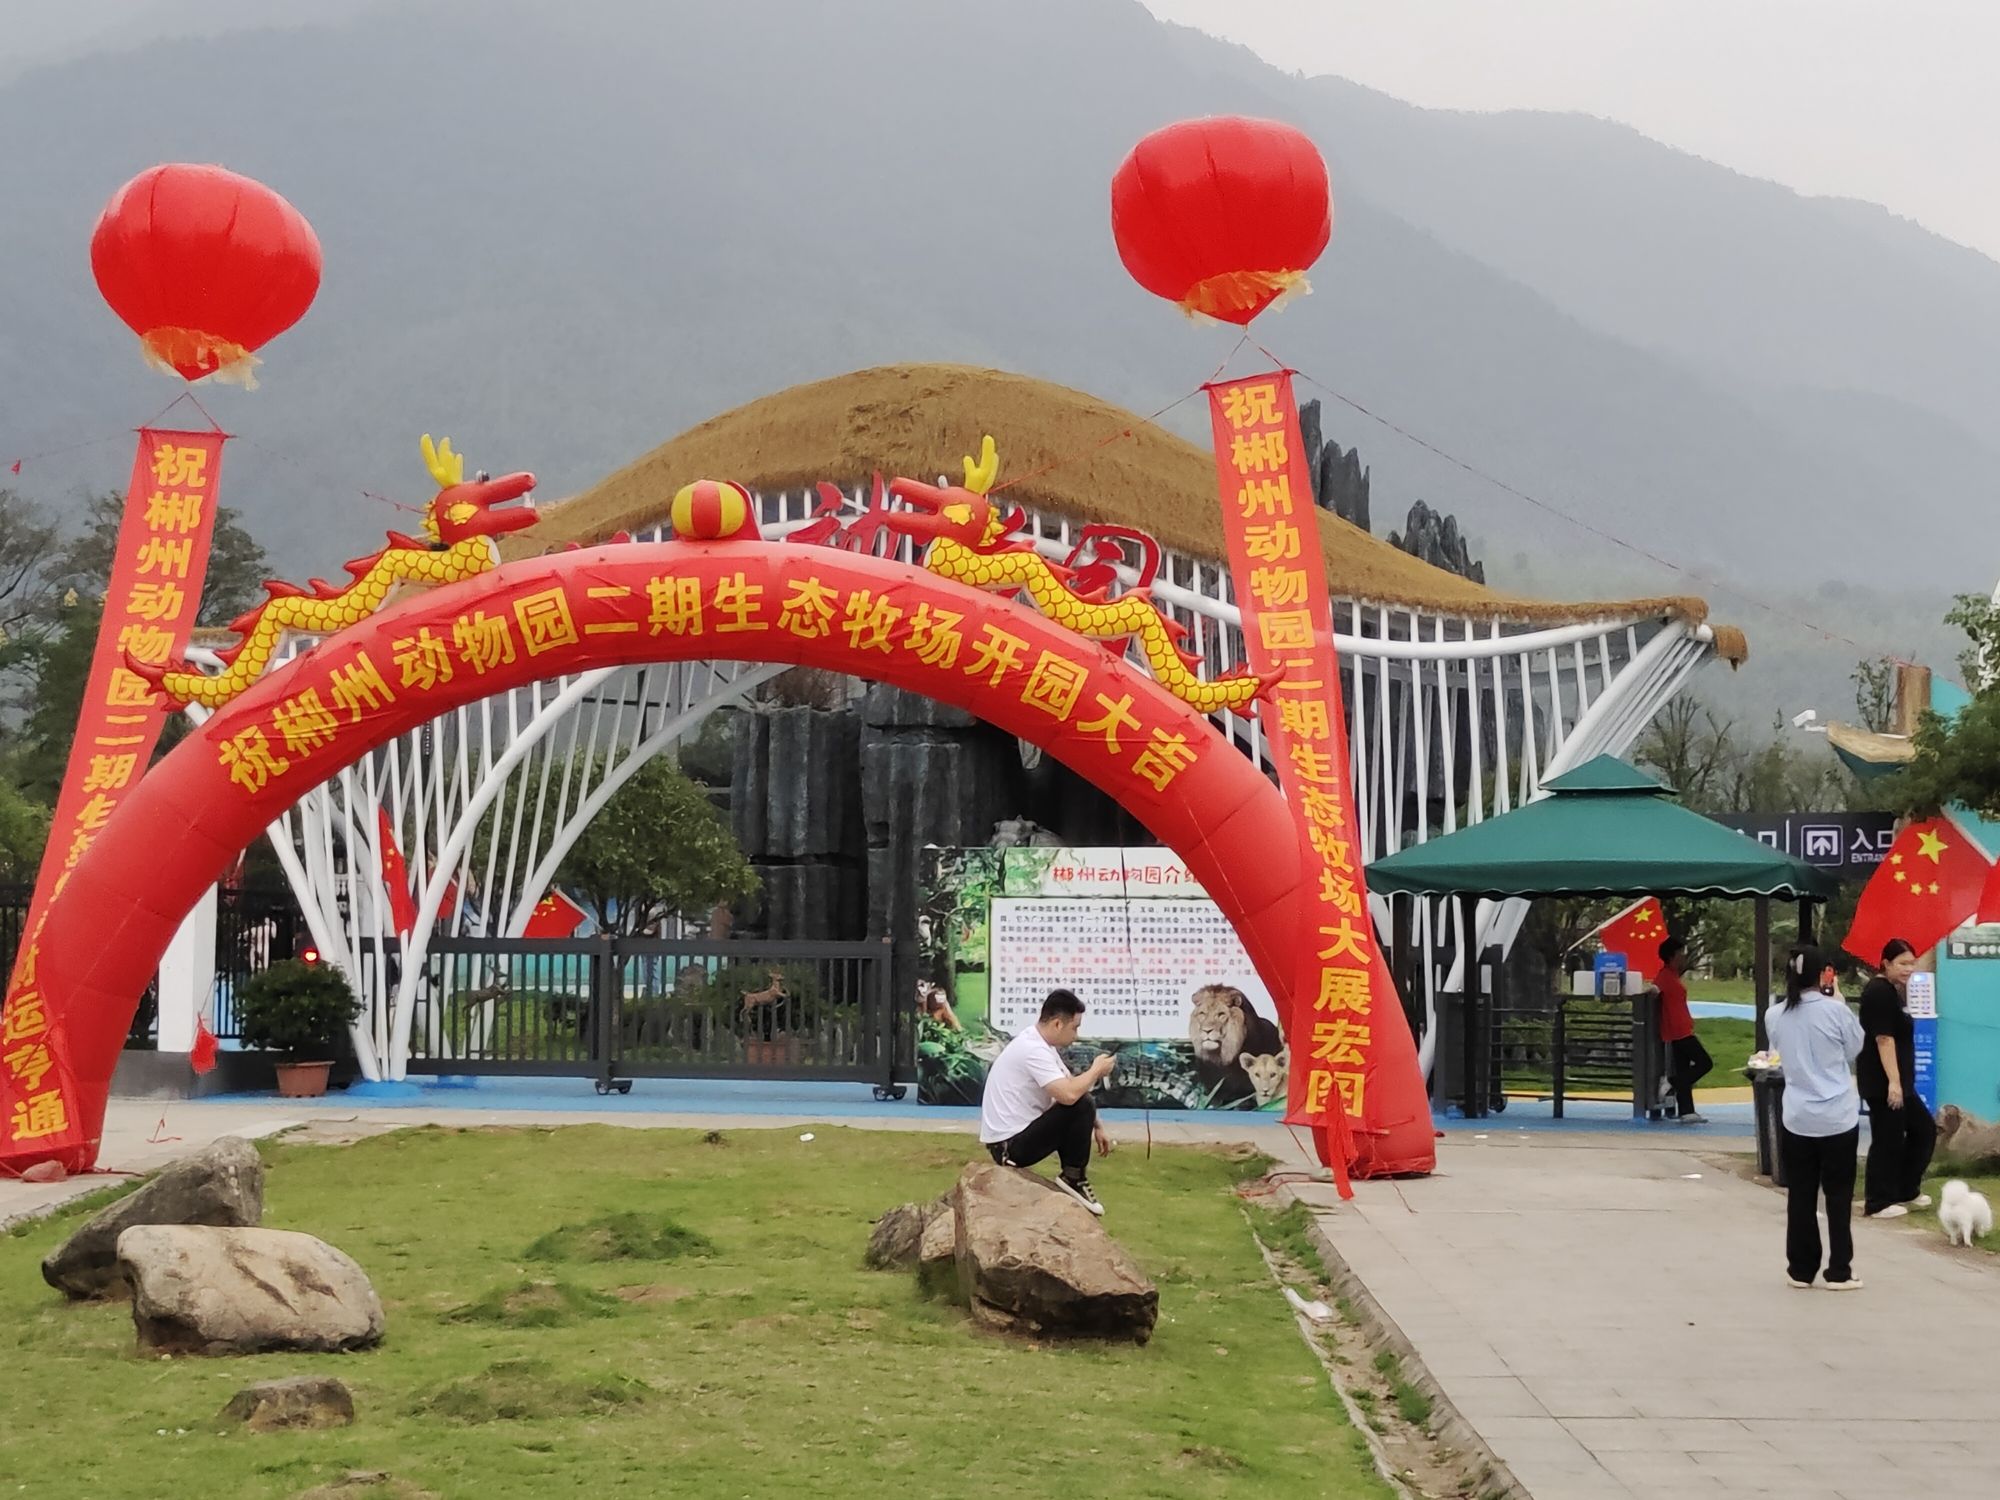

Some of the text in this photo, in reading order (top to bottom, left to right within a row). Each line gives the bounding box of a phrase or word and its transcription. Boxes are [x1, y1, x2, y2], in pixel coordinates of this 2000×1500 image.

[218, 571, 1199, 795] 祝郴州动物园二期生态牧场开园大吉
[1850, 827, 1895, 851] 入口
